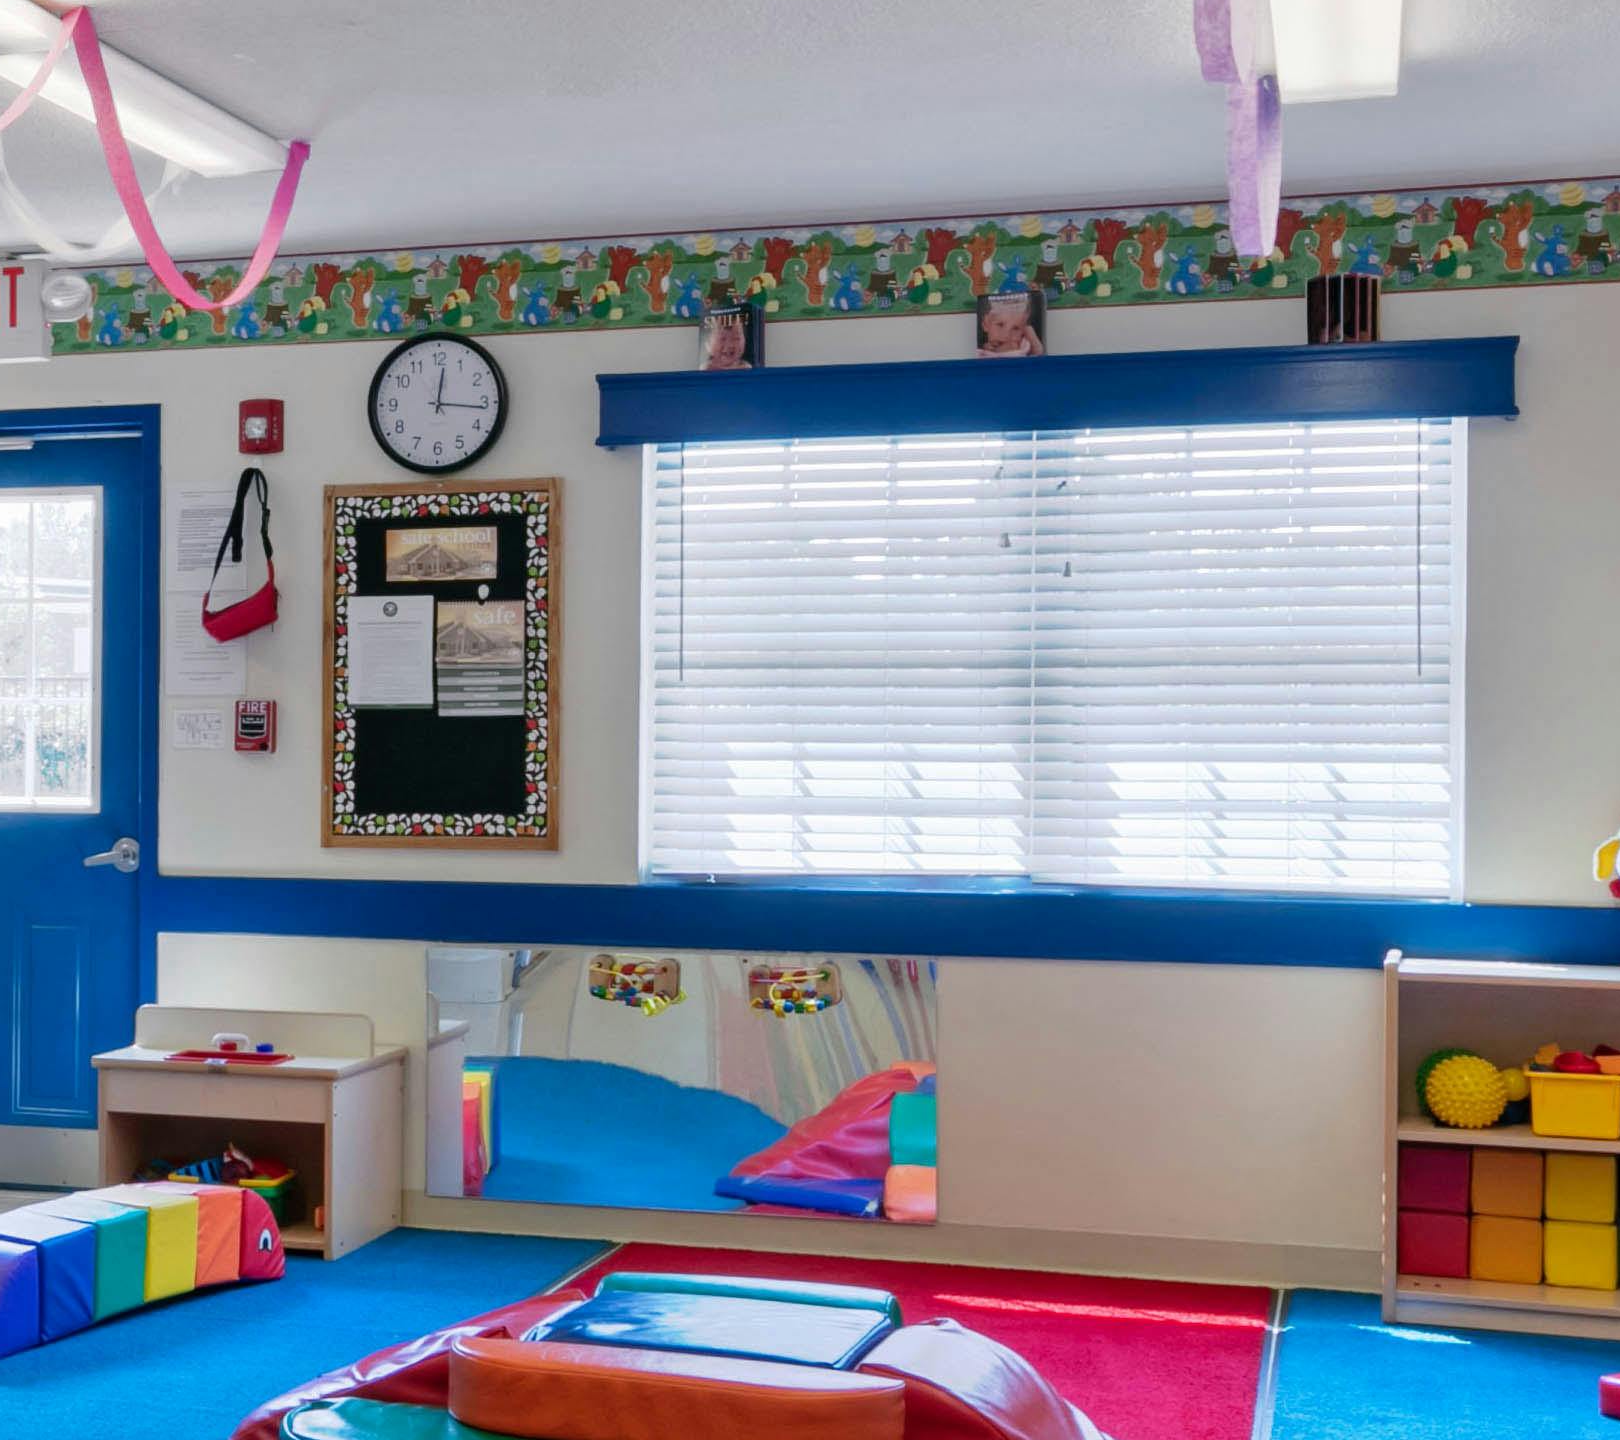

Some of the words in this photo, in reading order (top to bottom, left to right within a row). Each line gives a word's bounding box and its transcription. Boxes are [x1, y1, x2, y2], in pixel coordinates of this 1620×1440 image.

[433, 351, 447, 366] 12
[458, 359, 463, 372] 1
[411, 360, 423, 374] 11
[395, 374, 410, 388] 10
[472, 372, 482, 387] 2
[388, 398, 398, 412] 9
[480, 395, 489, 409] 3
[395, 419, 404, 433] 8
[471, 419, 481, 432] 4
[412, 436, 422, 450] 7
[433, 441, 443, 455] 6
[455, 435, 464, 449] 5
[238, 701, 267, 713] FIRE
